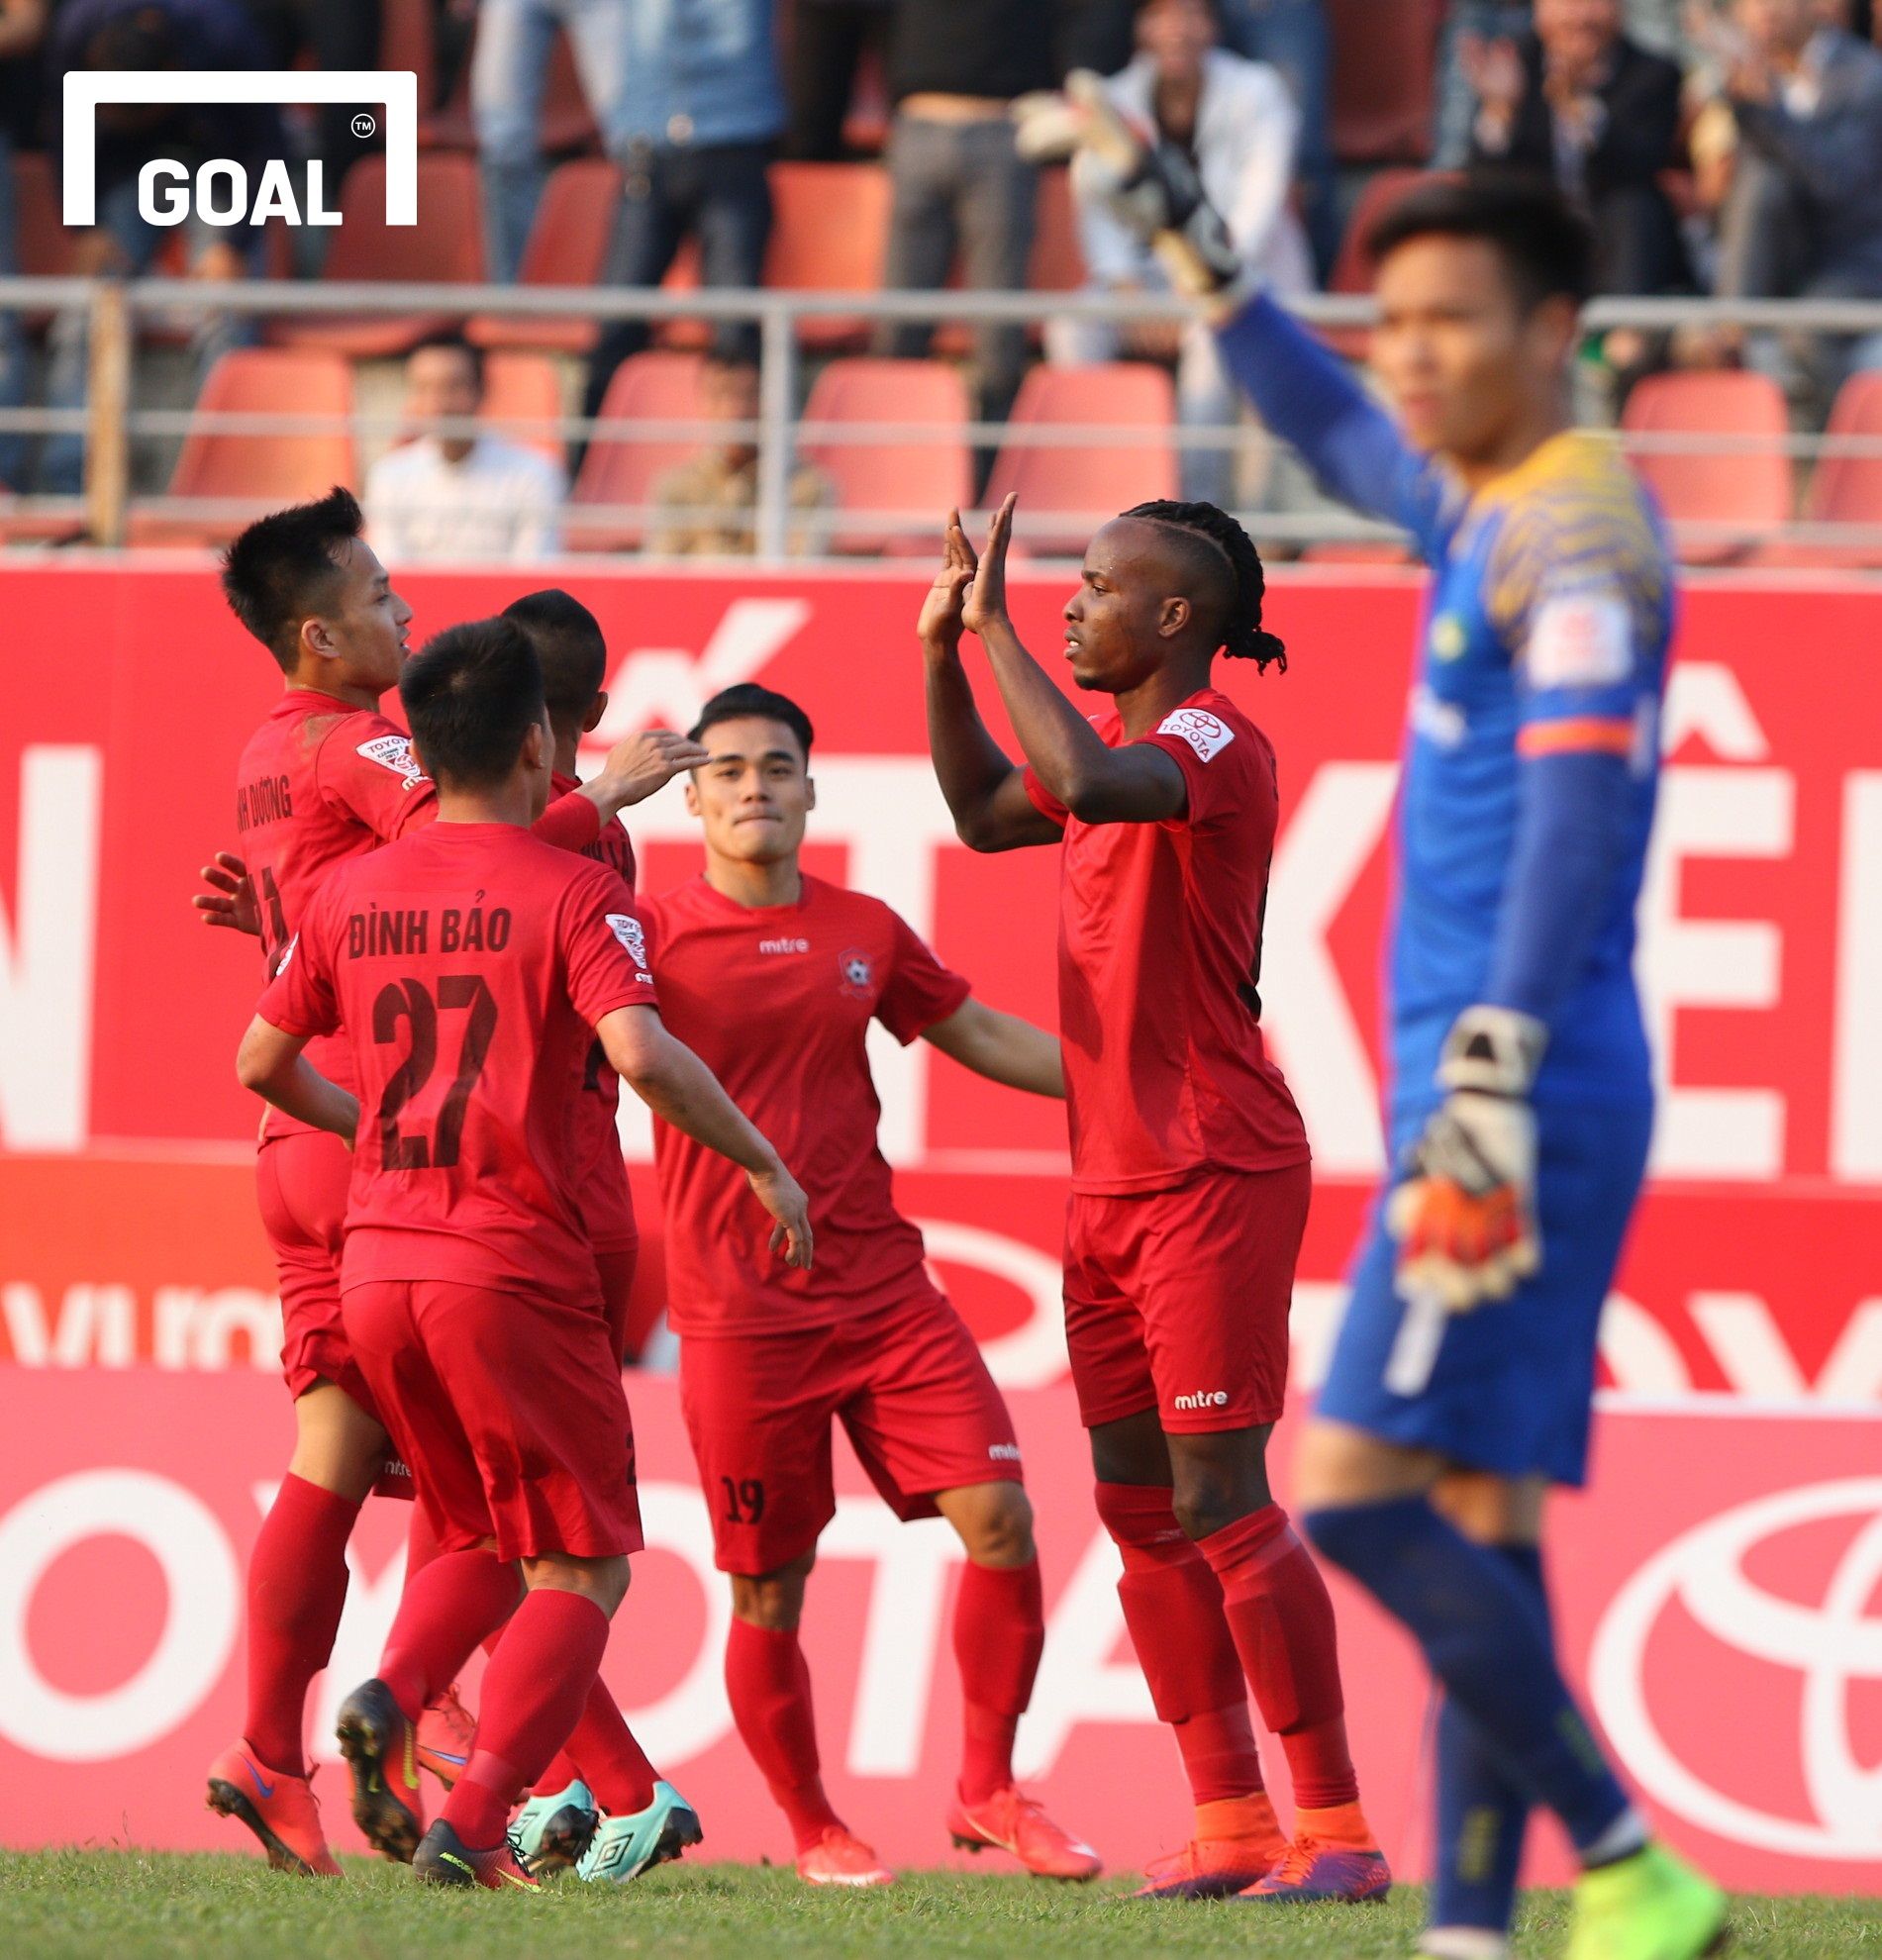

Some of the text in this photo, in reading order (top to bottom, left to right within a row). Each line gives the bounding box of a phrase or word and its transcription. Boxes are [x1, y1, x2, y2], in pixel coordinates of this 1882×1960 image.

[1162, 724, 1210, 758] TOYOTA
[348, 889, 512, 959] ĐÌNH BẢO
[758, 936, 810, 955] mitre
[372, 974, 499, 1172] 27
[1174, 1390, 1228, 1411] mitre
[721, 1475, 764, 1525] 19
